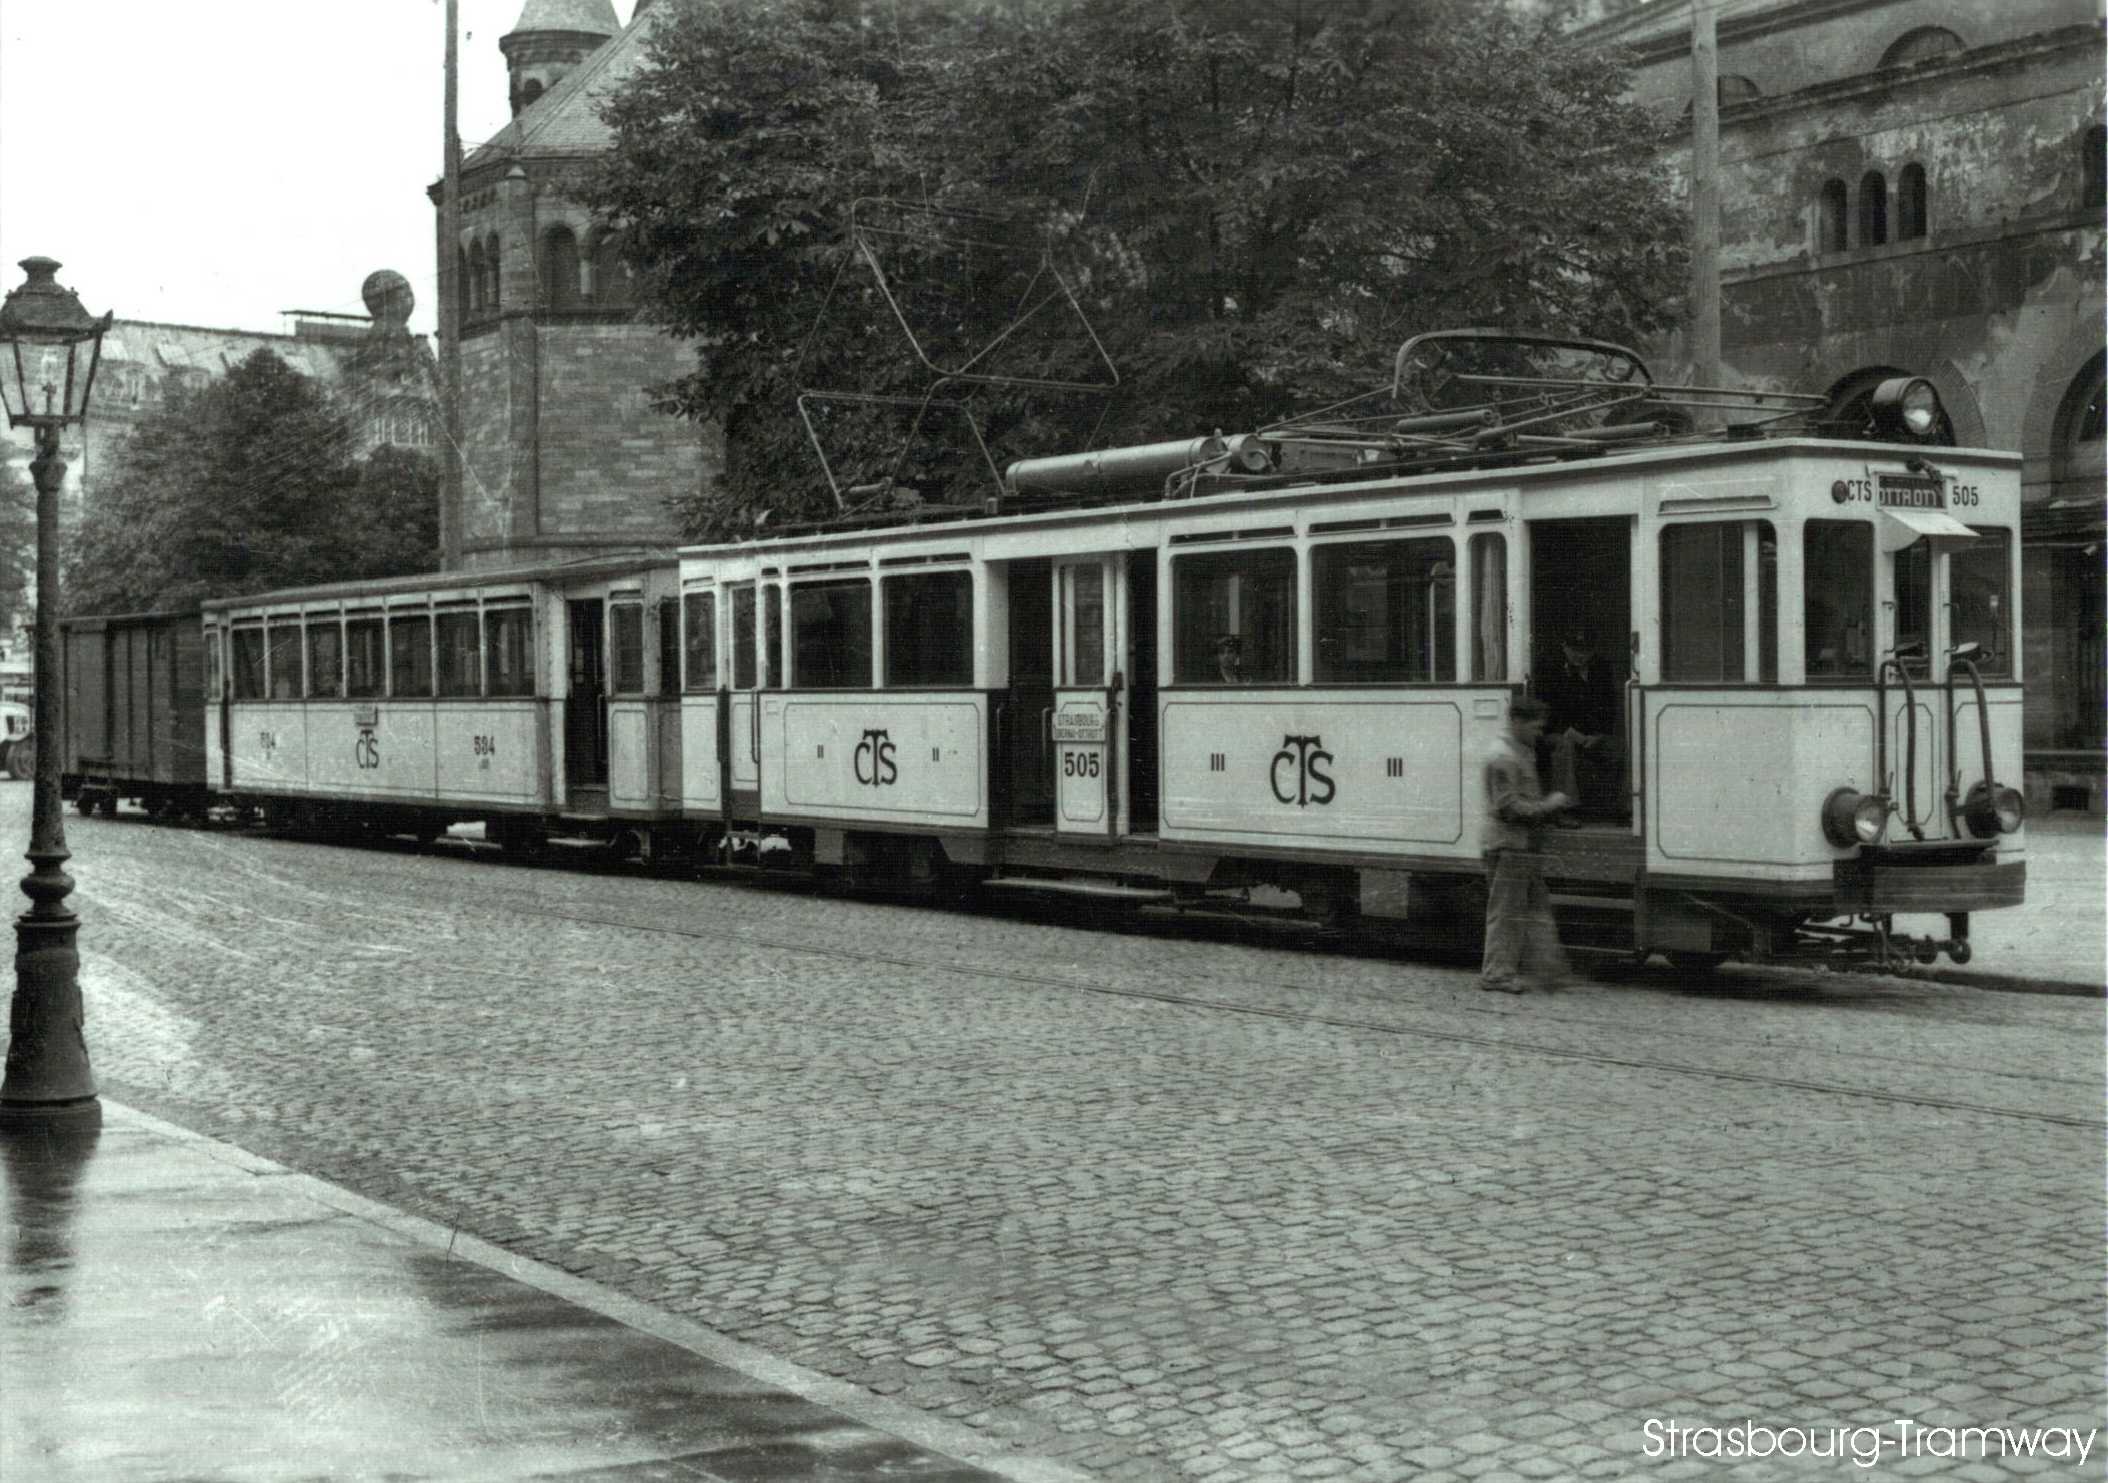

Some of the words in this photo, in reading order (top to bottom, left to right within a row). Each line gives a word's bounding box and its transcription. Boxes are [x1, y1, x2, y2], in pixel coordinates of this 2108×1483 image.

[1847, 480, 1872, 501] CTS
[1953, 486, 1979, 507] 505
[853, 728, 898, 788] CTS
[1064, 751, 1100, 778] 505
[1269, 734, 1337, 808] CTS
